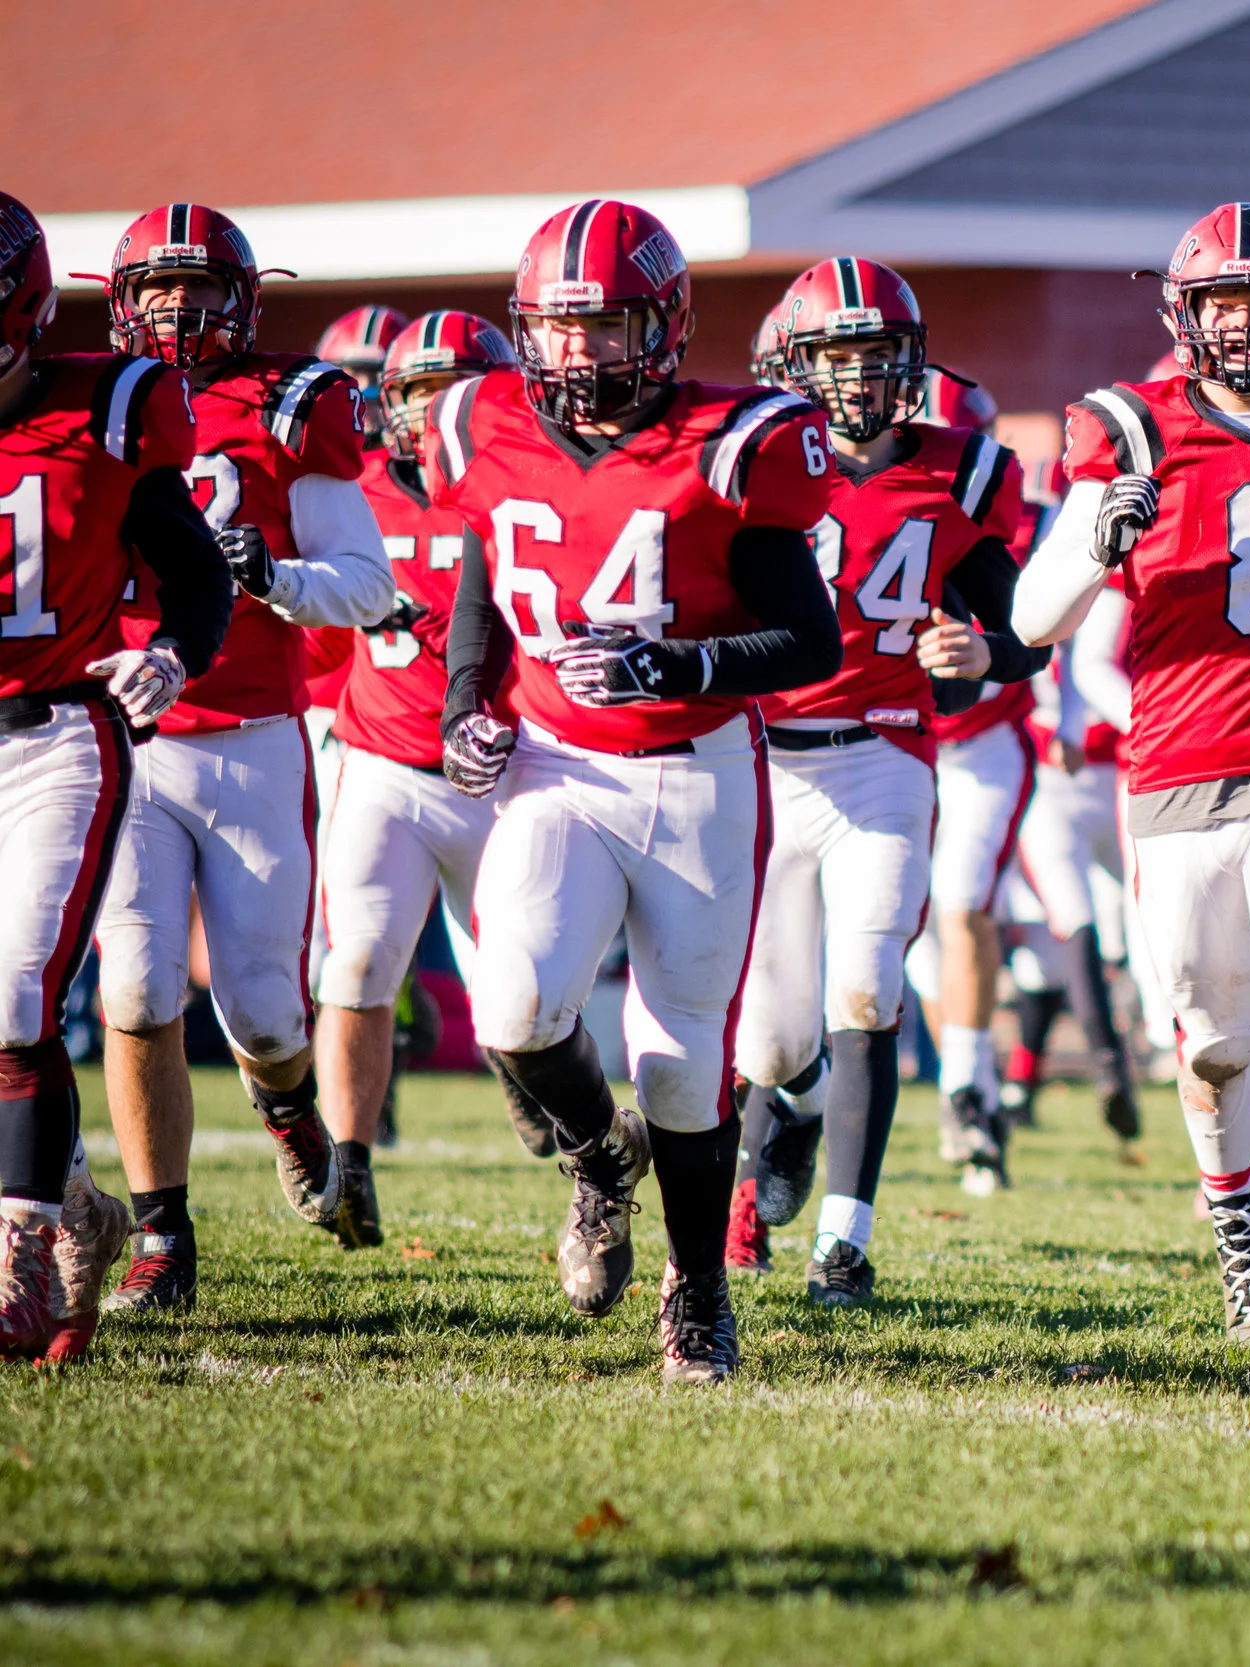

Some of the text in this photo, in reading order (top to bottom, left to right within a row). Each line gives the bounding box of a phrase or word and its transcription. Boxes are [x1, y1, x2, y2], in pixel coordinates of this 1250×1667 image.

[348, 387, 366, 432] 7
[490, 498, 675, 661] 64
[143, 1235, 176, 1252] NIKE
